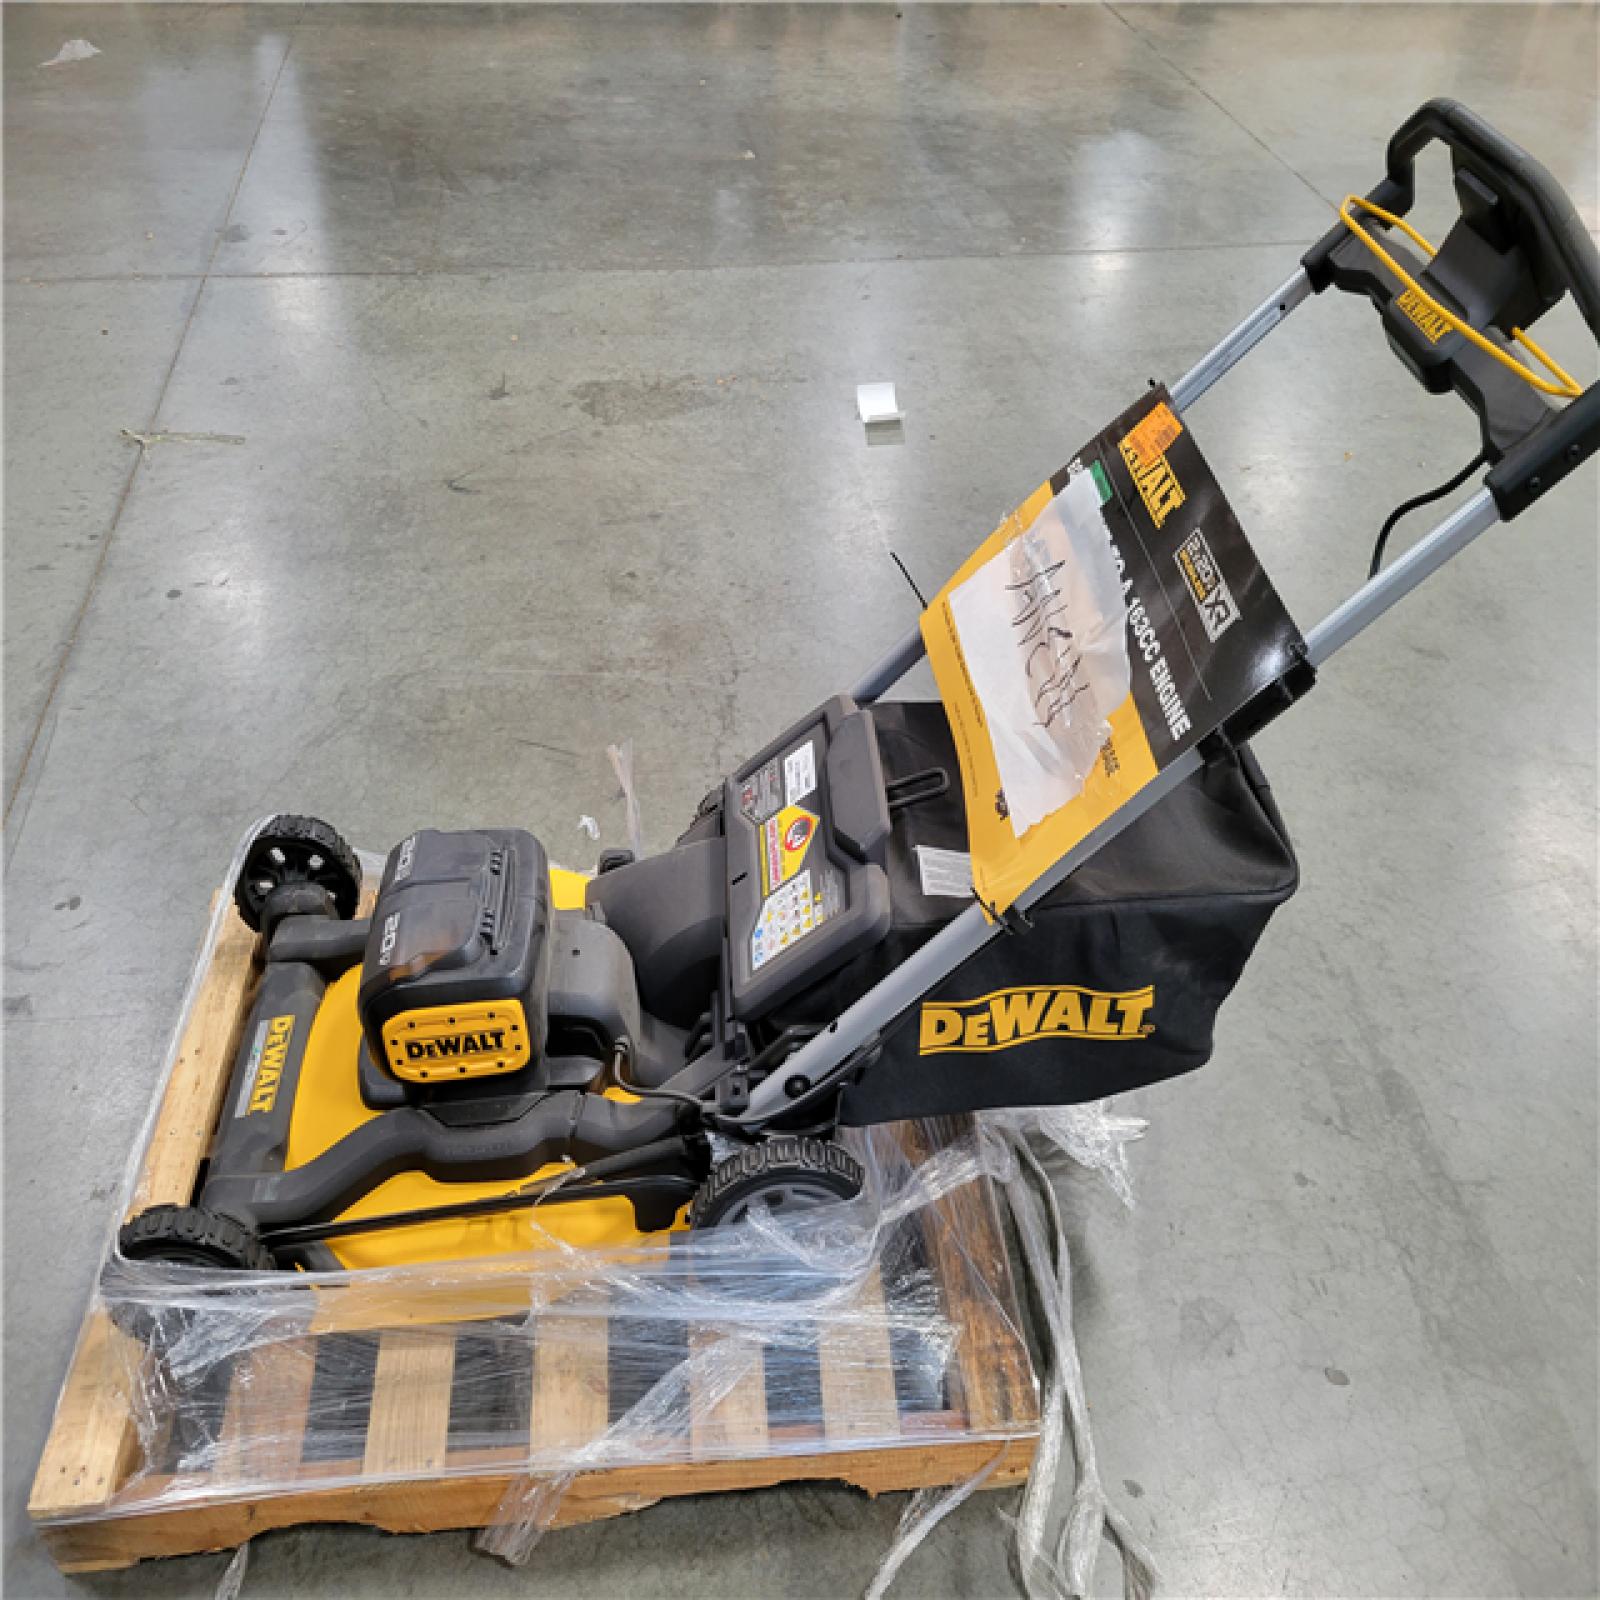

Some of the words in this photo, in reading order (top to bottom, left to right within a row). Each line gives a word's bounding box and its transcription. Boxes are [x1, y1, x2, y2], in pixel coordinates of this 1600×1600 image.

[1149, 656, 1192, 741] ENGINE
[406, 1029, 505, 1059] DEWALT
[921, 987, 1155, 1052] DEWALT
[247, 1014, 296, 1114] DEWALT
